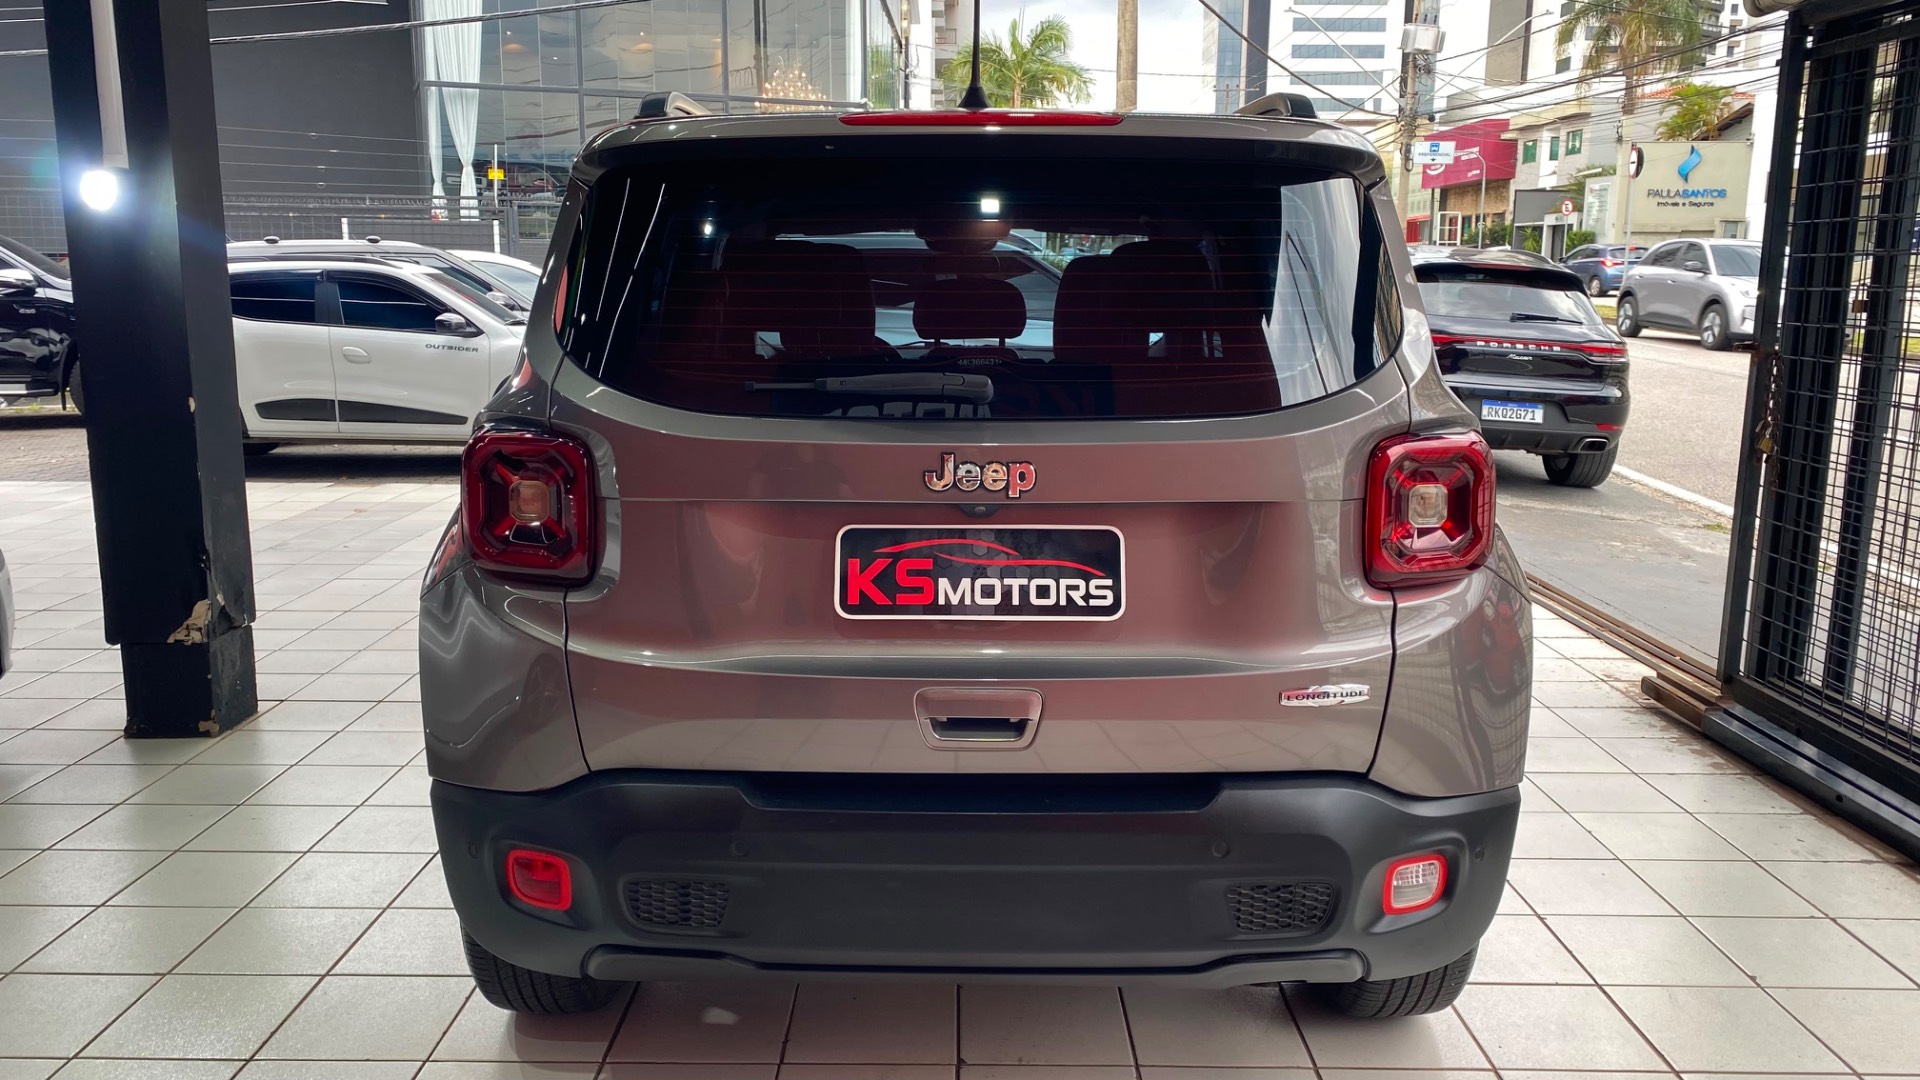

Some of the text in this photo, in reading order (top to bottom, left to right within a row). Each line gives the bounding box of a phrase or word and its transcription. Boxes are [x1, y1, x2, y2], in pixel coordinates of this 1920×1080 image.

[425, 343, 479, 352] OUTSIDER
[1476, 341, 1561, 351] PORSCHE
[1487, 406, 1536, 420] RKQ2G71
[924, 452, 1037, 498] Jeep
[1286, 690, 1367, 701] LONGITUDE
